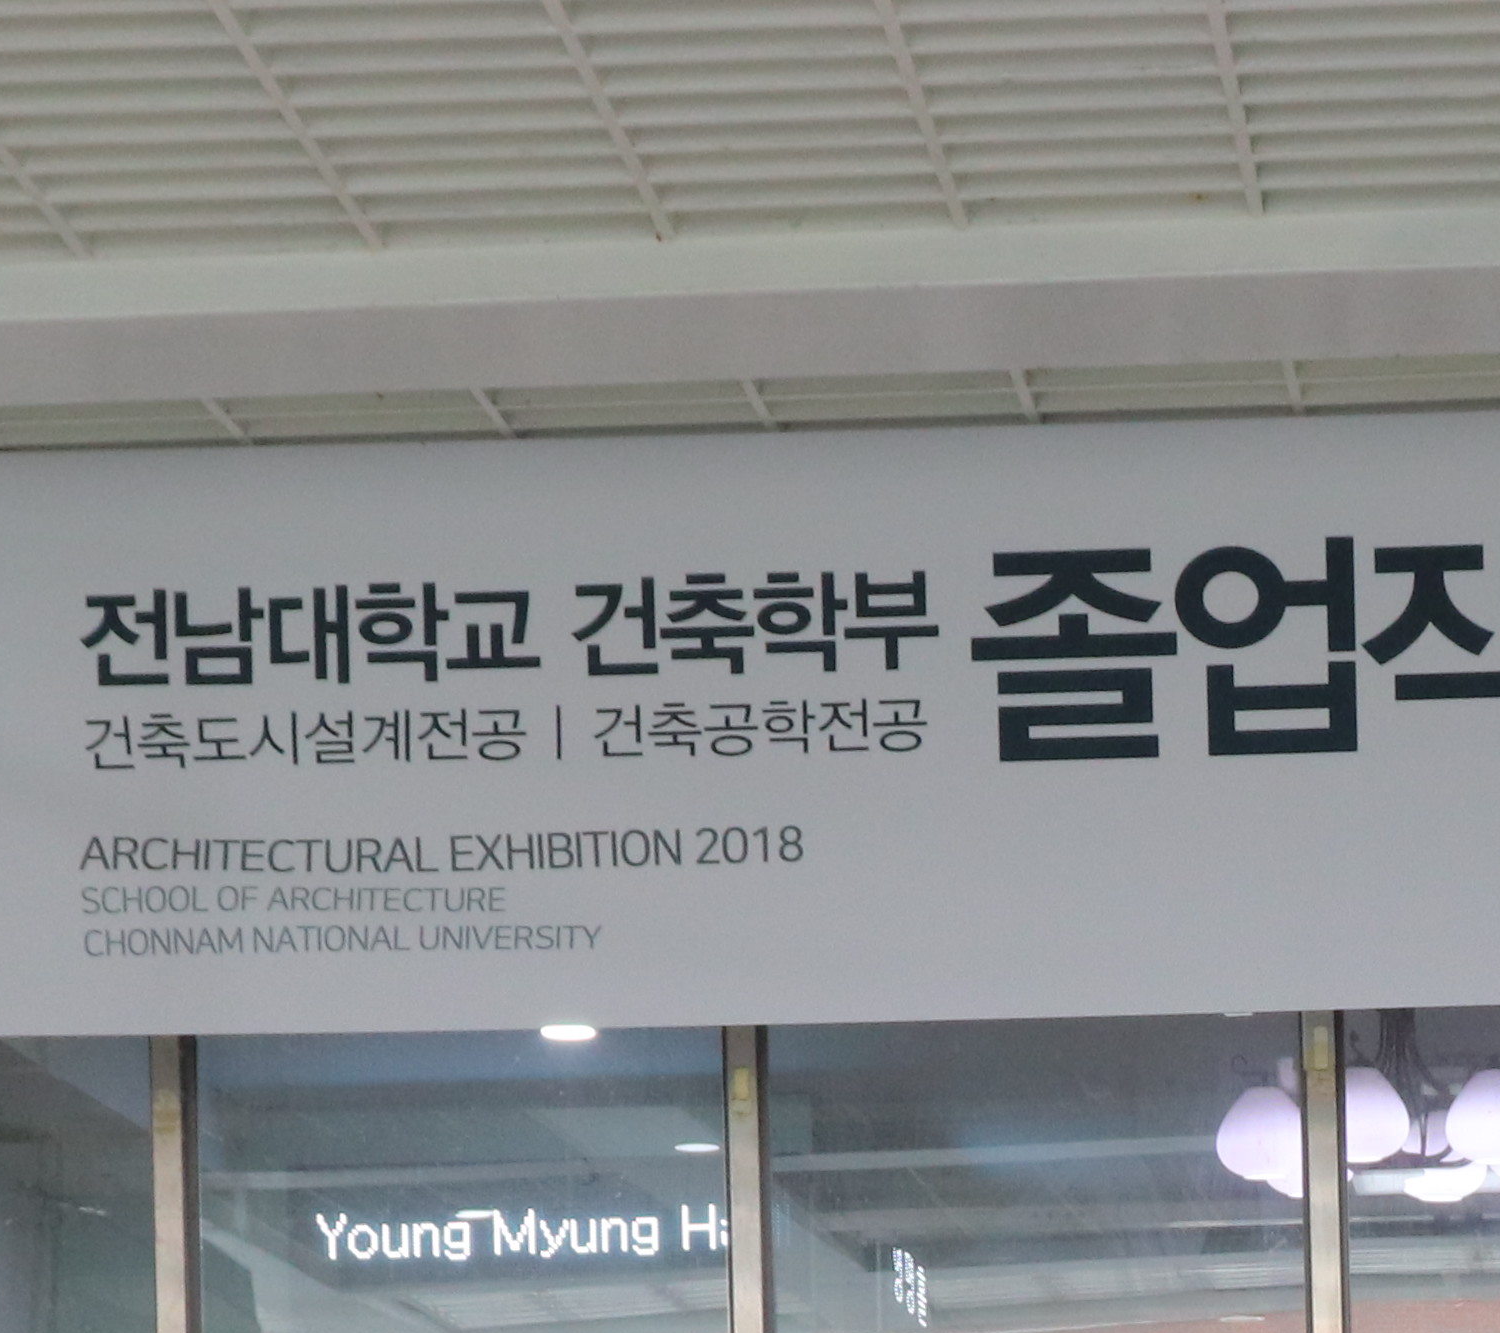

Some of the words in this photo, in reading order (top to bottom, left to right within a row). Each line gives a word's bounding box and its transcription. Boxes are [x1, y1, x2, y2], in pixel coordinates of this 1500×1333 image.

[81, 582, 541, 687] 전남대학교
[572, 570, 940, 677] 건축학부
[85, 708, 527, 770] 건축도시설계전공
[593, 698, 928, 757] 건축공학전공
[80, 835, 439, 875] ARCHITECTURAL
[449, 828, 682, 872] EXHIBITION
[695, 824, 805, 865] 2018
[80, 885, 209, 915] SCHOOL
[216, 885, 258, 912] OF
[266, 885, 506, 913] ARCHITECTURE
[83, 926, 244, 957] CHONNAM
[251, 924, 410, 954] NATIONAL
[418, 924, 603, 951] UNIVERSITY
[315, 1211, 471, 1261] Young
[492, 1207, 660, 1257] Myung
